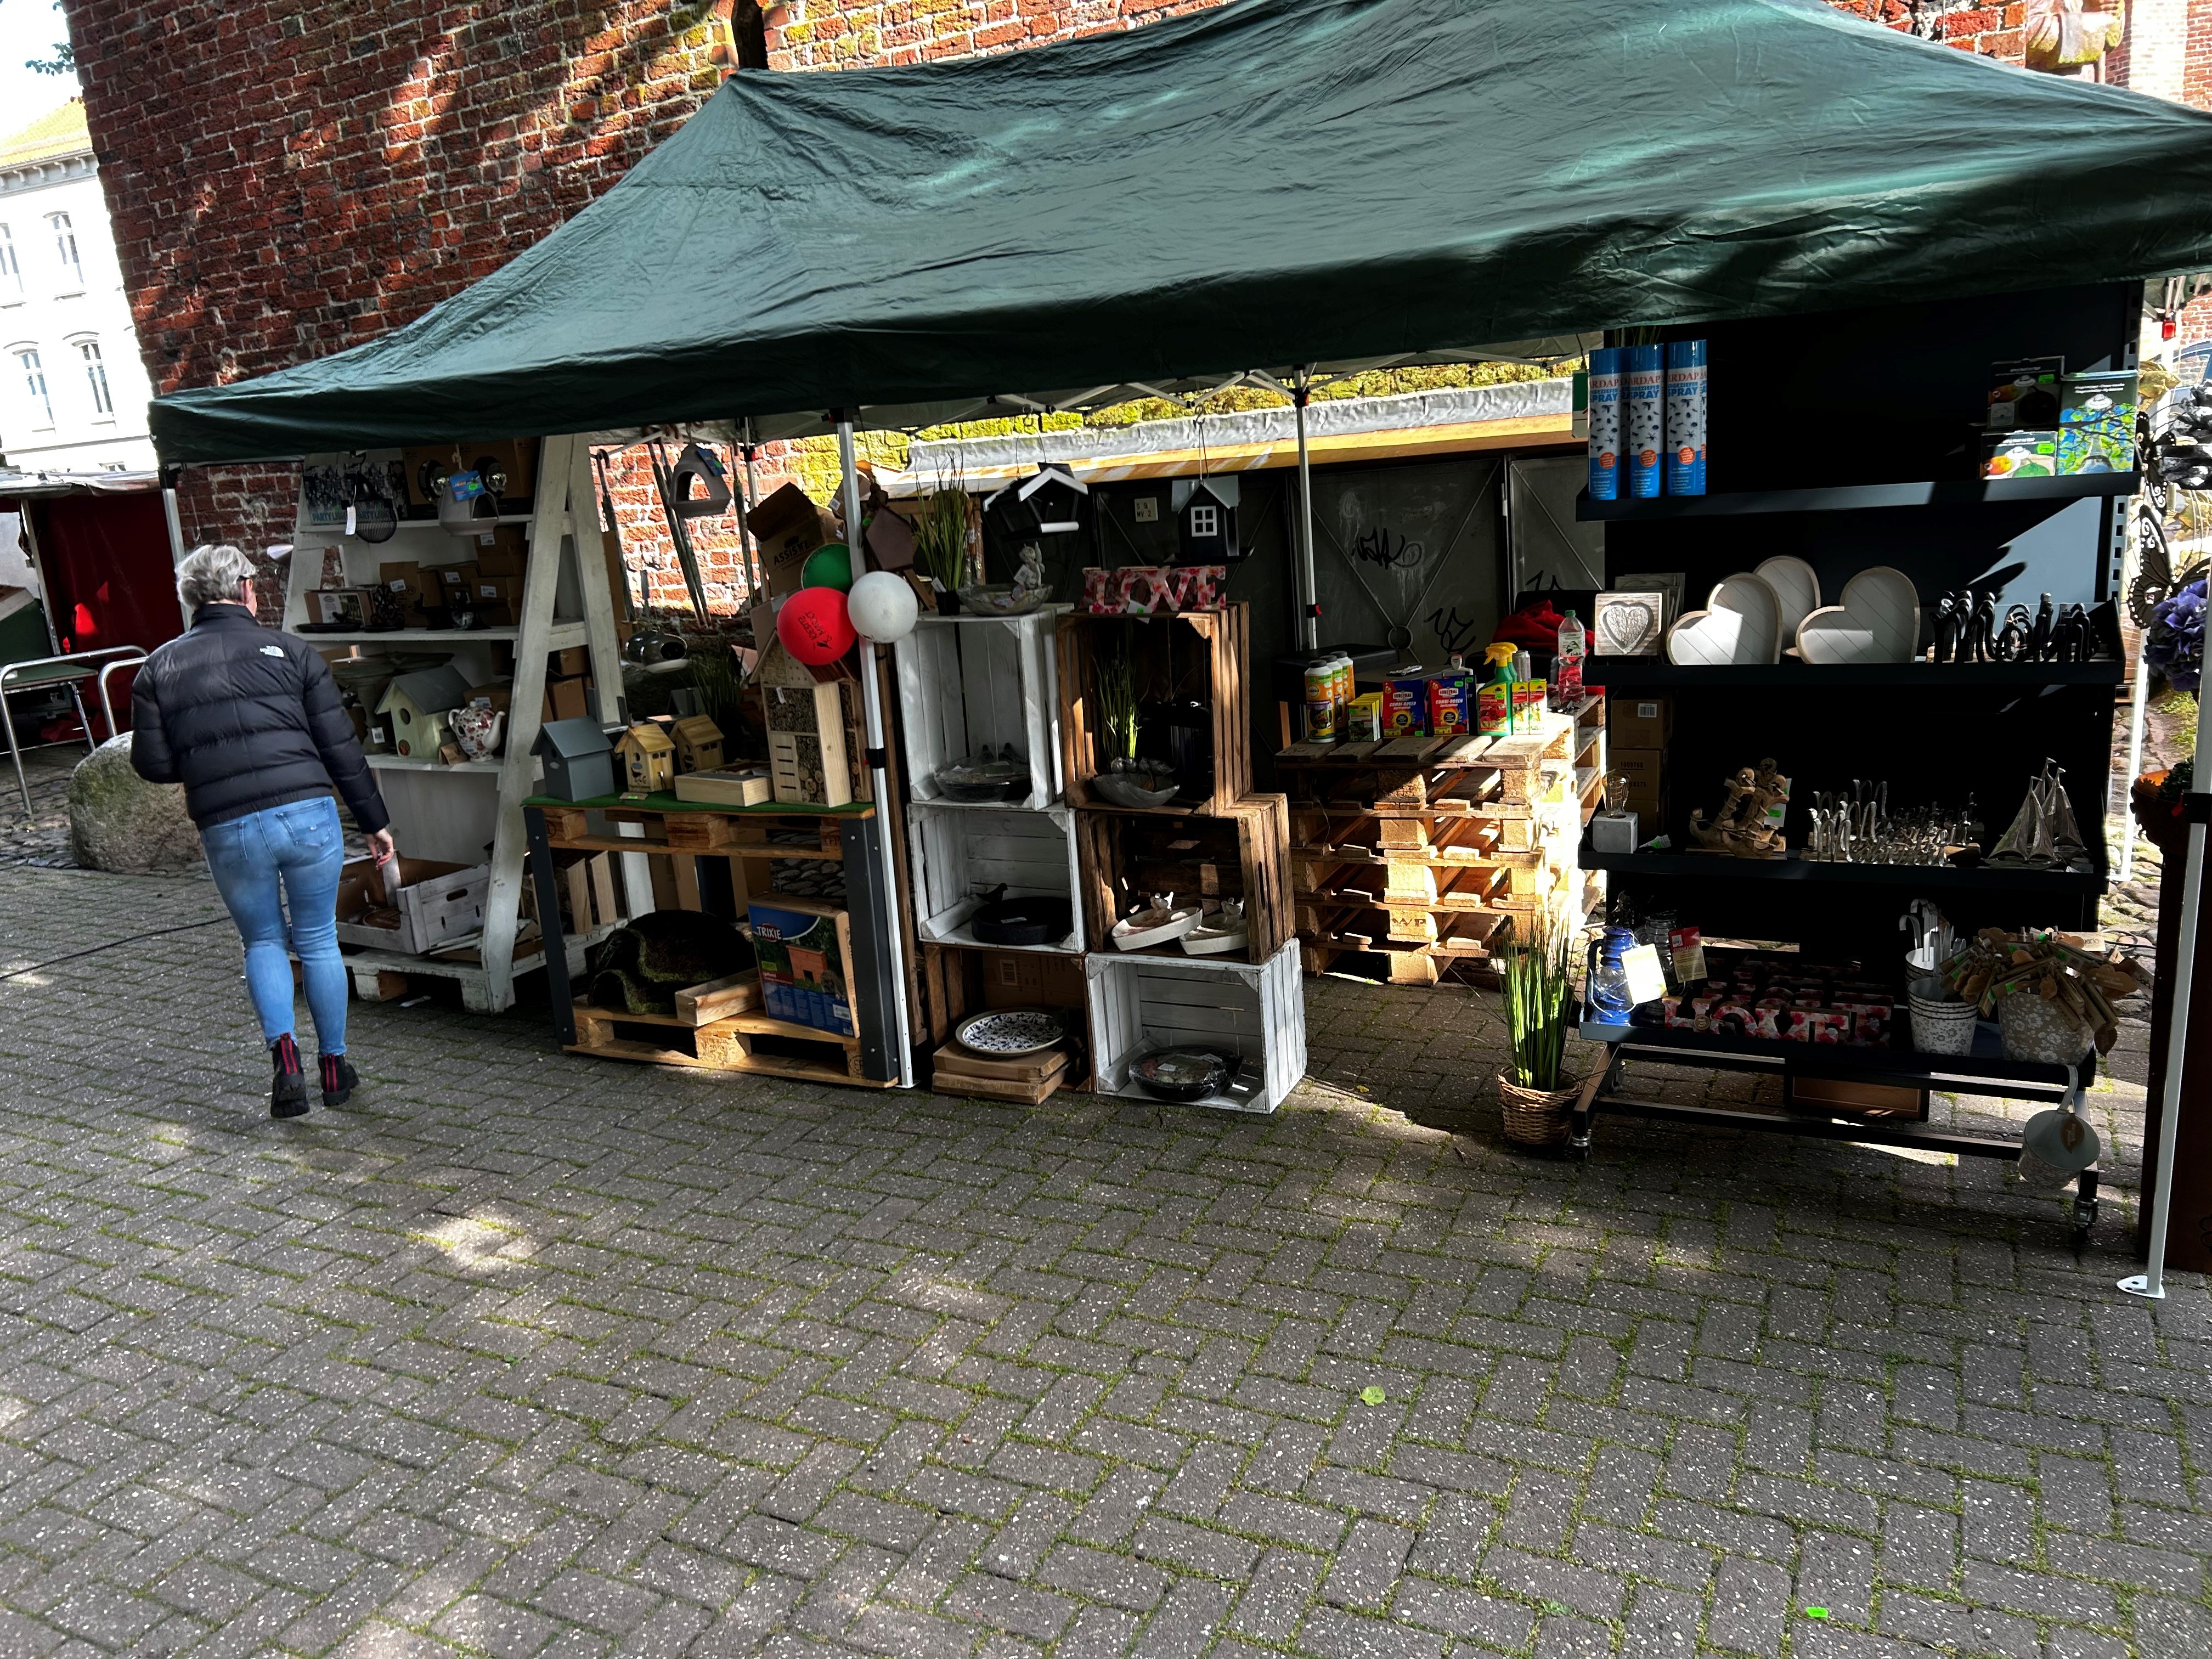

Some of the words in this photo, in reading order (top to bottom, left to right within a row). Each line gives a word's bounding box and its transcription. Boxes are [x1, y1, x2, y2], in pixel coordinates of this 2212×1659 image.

[1590, 379, 1620, 389] RDAP
[1590, 393, 1618, 403] PRAY
[1087, 566, 1227, 614] LOVE
[755, 926, 783, 941] TRIXIE
